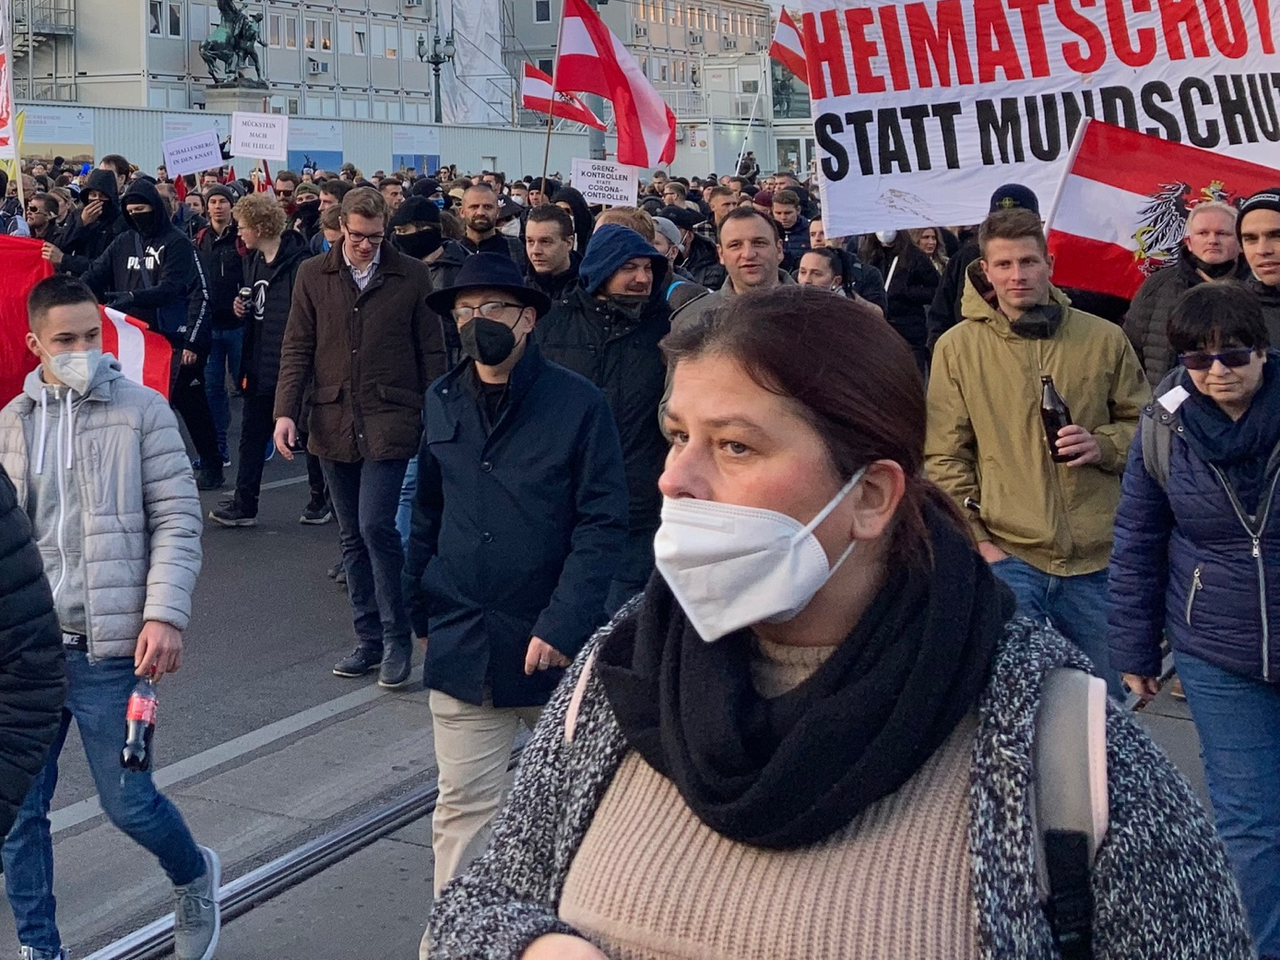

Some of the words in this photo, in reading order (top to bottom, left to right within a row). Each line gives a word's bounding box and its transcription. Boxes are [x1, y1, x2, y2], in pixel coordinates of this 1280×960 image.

[241, 120, 276, 129] MÜCKSTEIN
[249, 131, 267, 139] MACH
[815, 102, 961, 182] STATT
[169, 141, 214, 157] SCHALLENBERG
[194, 151, 213, 160] KNAST
[591, 164, 618, 172] GRENZ-
[581, 171, 628, 181] KONTROLLEN
[588, 184, 623, 192] CORONA-
[582, 190, 629, 201] KONTROLLEN
